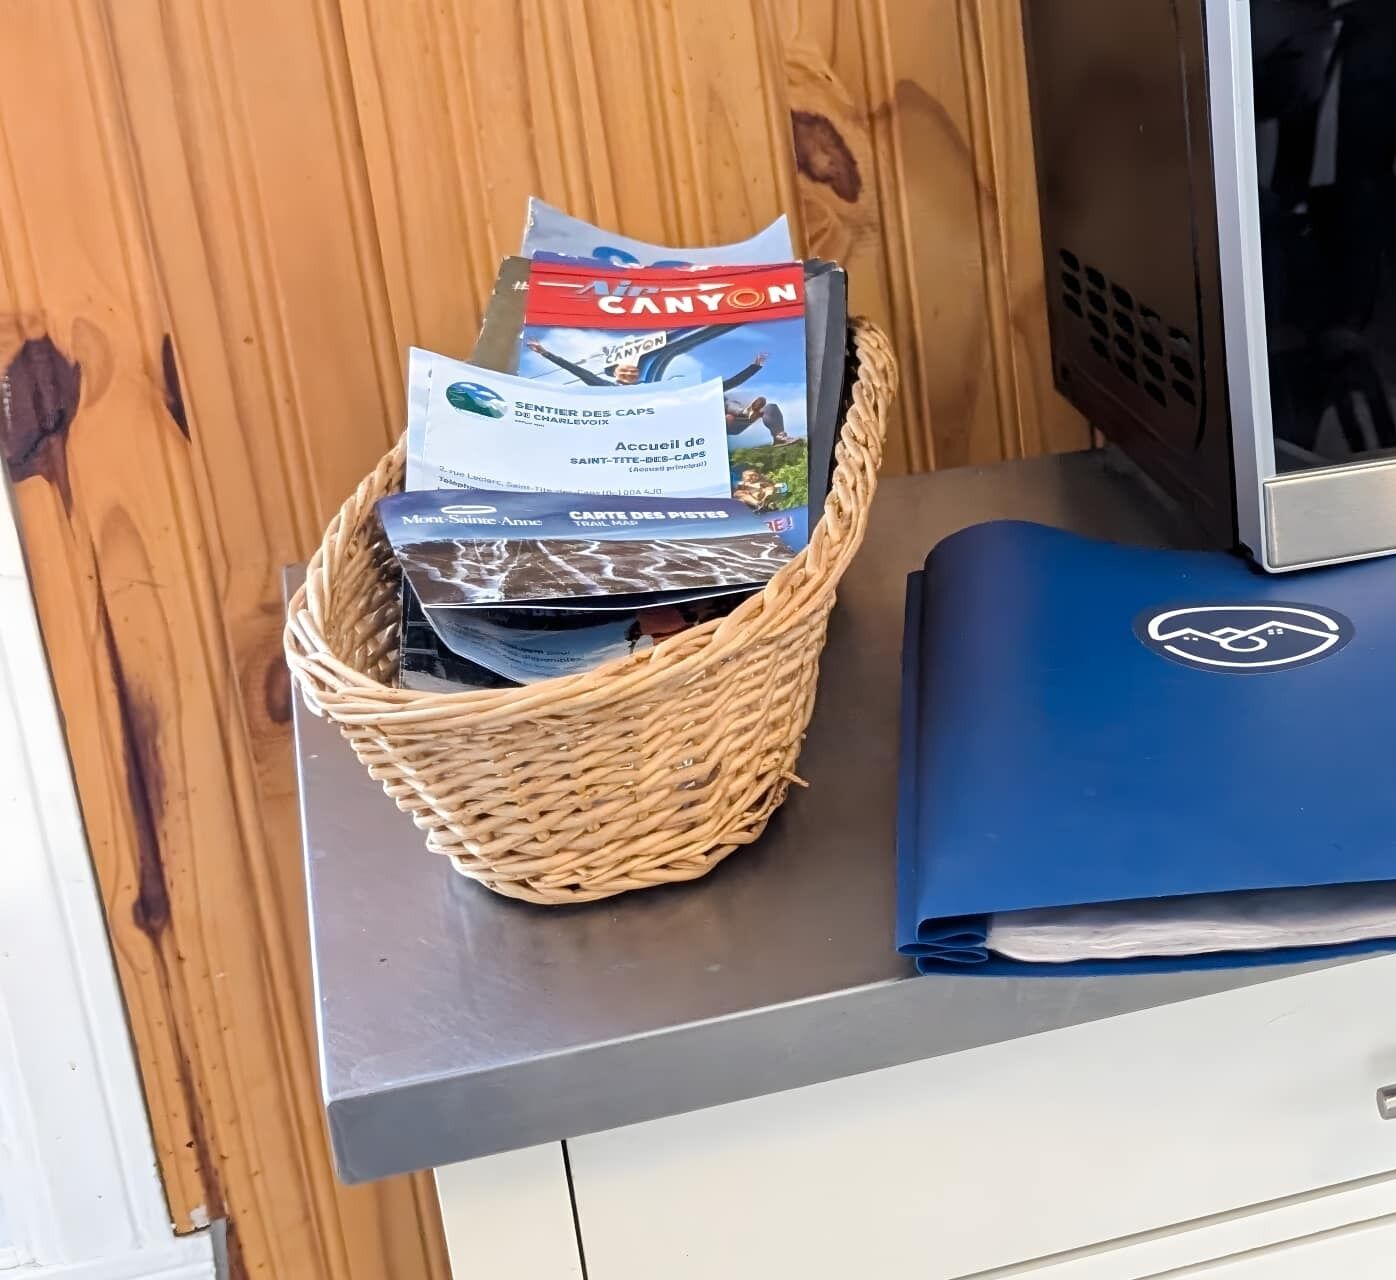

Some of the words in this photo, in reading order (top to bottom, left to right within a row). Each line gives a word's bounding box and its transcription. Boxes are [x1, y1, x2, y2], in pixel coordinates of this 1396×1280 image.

[577, 280, 660, 297] Air
[598, 283, 798, 314] CANYON
[515, 401, 578, 417] SENTIER
[582, 410, 611, 418] DES
[615, 408, 655, 417] CAPS
[515, 411, 530, 419] DE
[534, 414, 609, 425] CHARLEVOIX
[615, 439, 679, 451] Accueil
[685, 437, 705, 449] de
[570, 451, 706, 465] SAINT-TITE-DES-CAPS
[569, 510, 629, 520] CARTE
[631, 510, 665, 520] DES
[668, 510, 729, 521] PISTES
